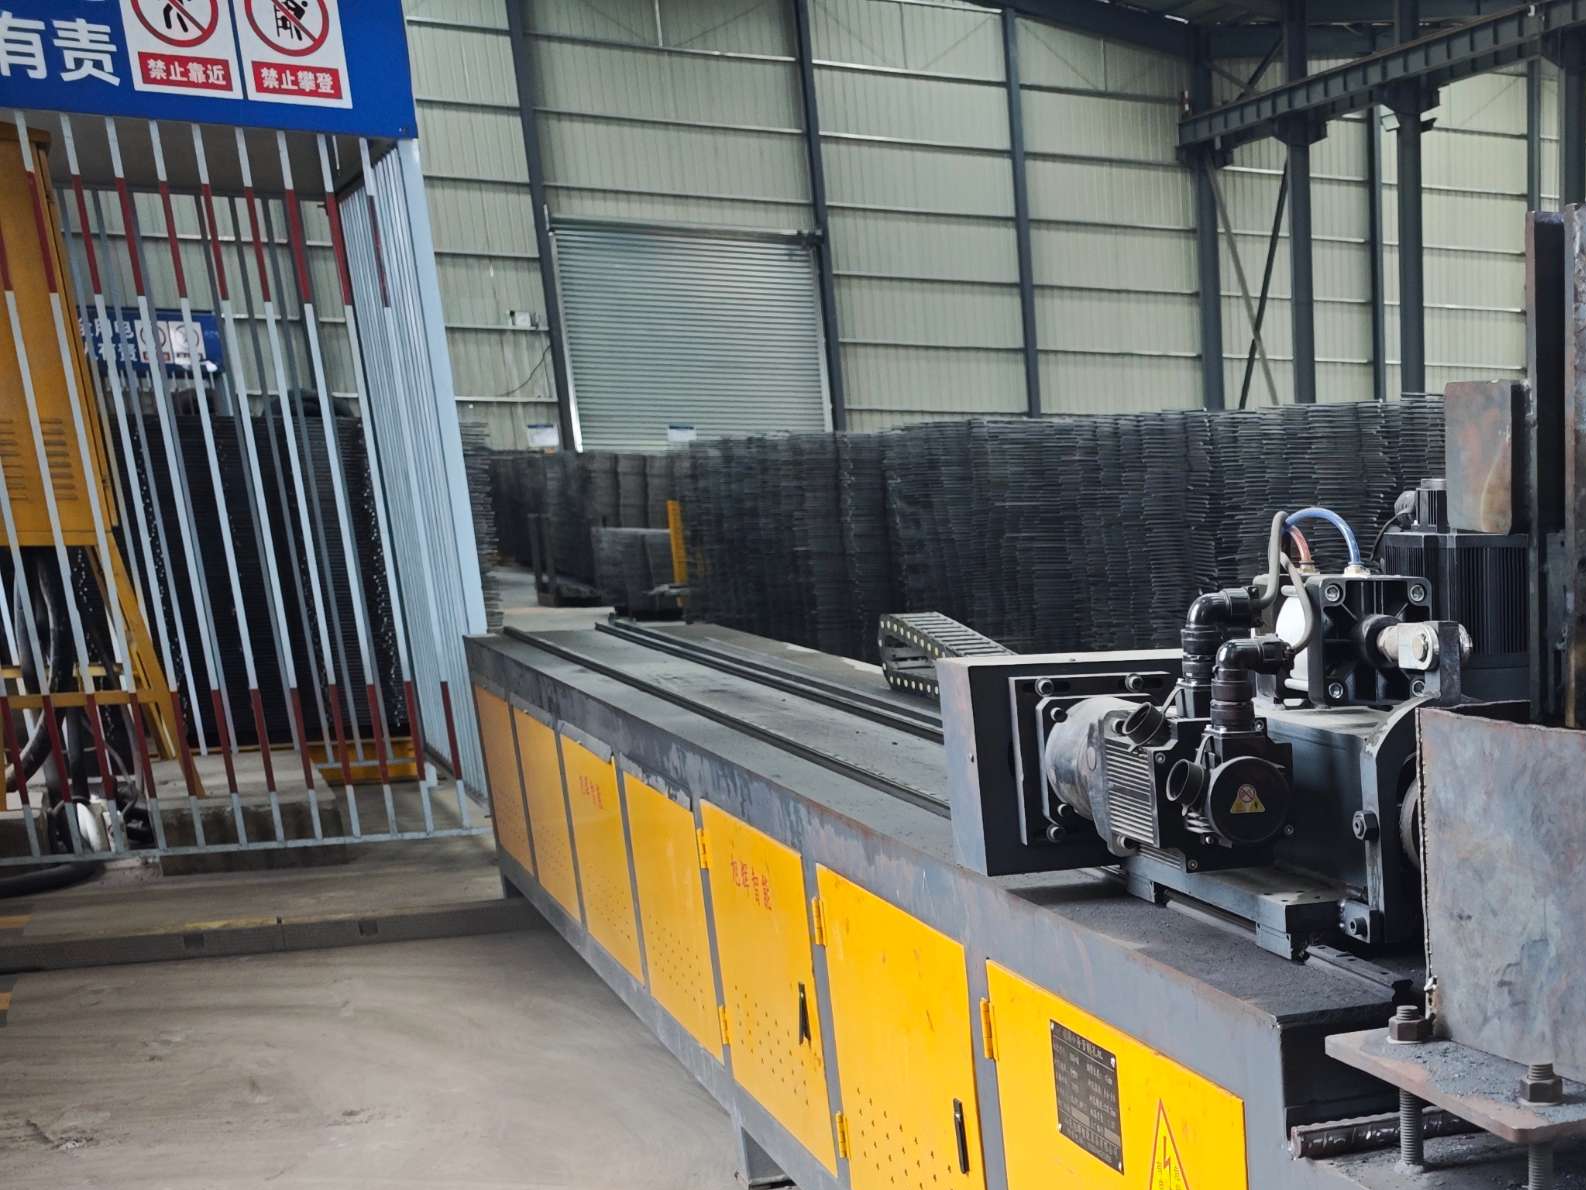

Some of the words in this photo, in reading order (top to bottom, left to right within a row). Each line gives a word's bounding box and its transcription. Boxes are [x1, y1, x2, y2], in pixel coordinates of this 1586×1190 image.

[0, 10, 120, 86] 有责
[147, 58, 227, 85] 禁止靠近
[260, 67, 335, 93] 禁止攀登
